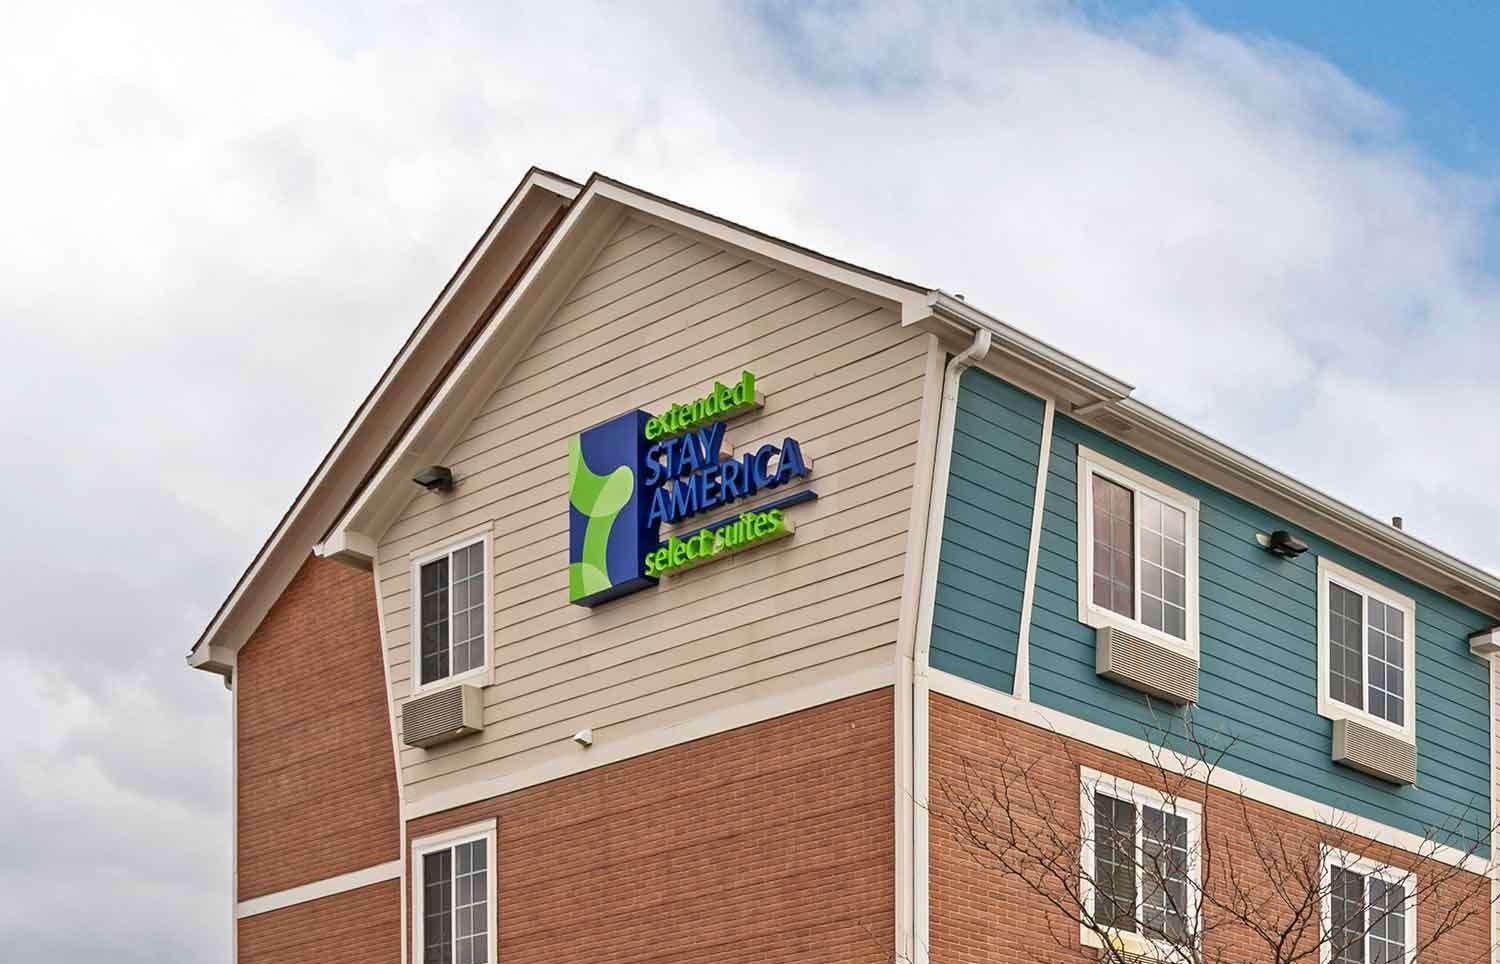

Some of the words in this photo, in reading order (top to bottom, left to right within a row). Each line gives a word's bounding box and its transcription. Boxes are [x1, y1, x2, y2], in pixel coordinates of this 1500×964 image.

[645, 370, 755, 440] extended
[645, 422, 727, 486] STAY
[648, 437, 806, 528] AMERICA
[645, 533, 714, 577] select
[713, 509, 784, 556] suites
